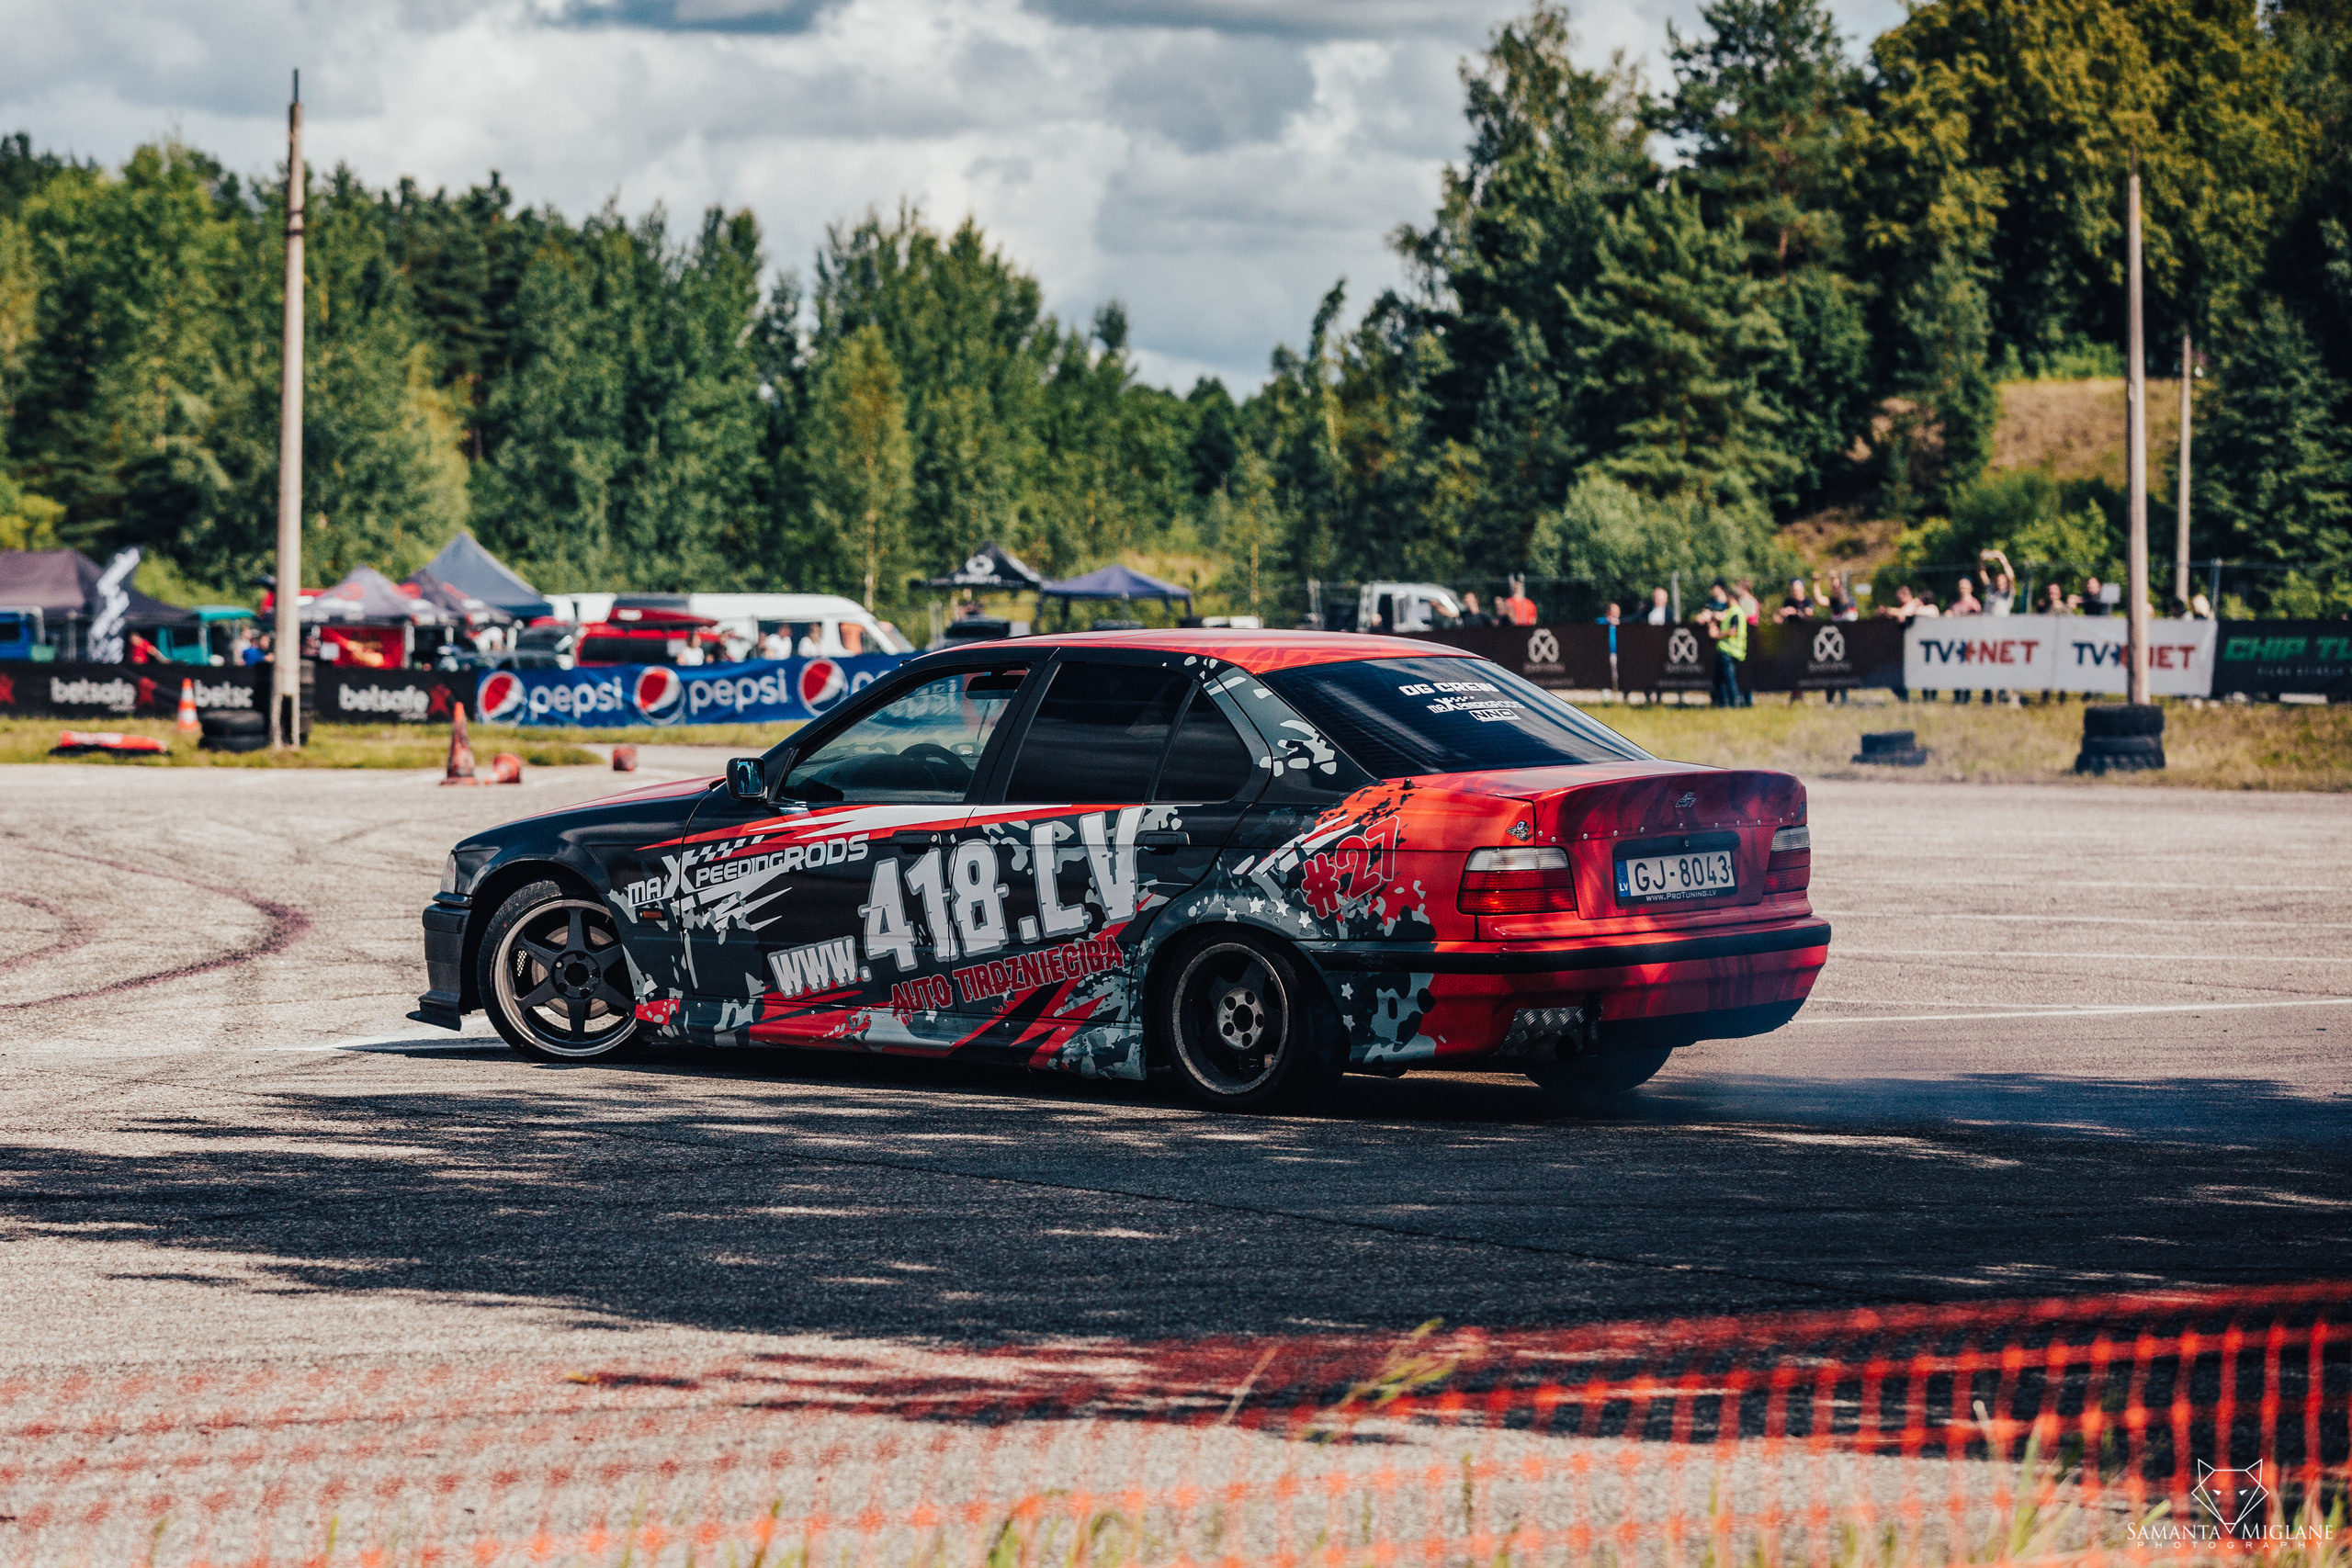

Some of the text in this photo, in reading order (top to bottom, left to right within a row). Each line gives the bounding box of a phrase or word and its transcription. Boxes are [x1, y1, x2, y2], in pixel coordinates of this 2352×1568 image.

[51, 677, 136, 705] betsafe
[338, 684, 429, 712] betsafe
[528, 676, 623, 721] pepsi
[690, 668, 788, 715] pepsi
[1398, 682, 1499, 695] OG CREW
[1301, 815, 1400, 919] #27
[1634, 854, 1730, 891] GJ-8043
[1619, 883, 1629, 892] LV
[889, 974, 953, 1018] AUTO
